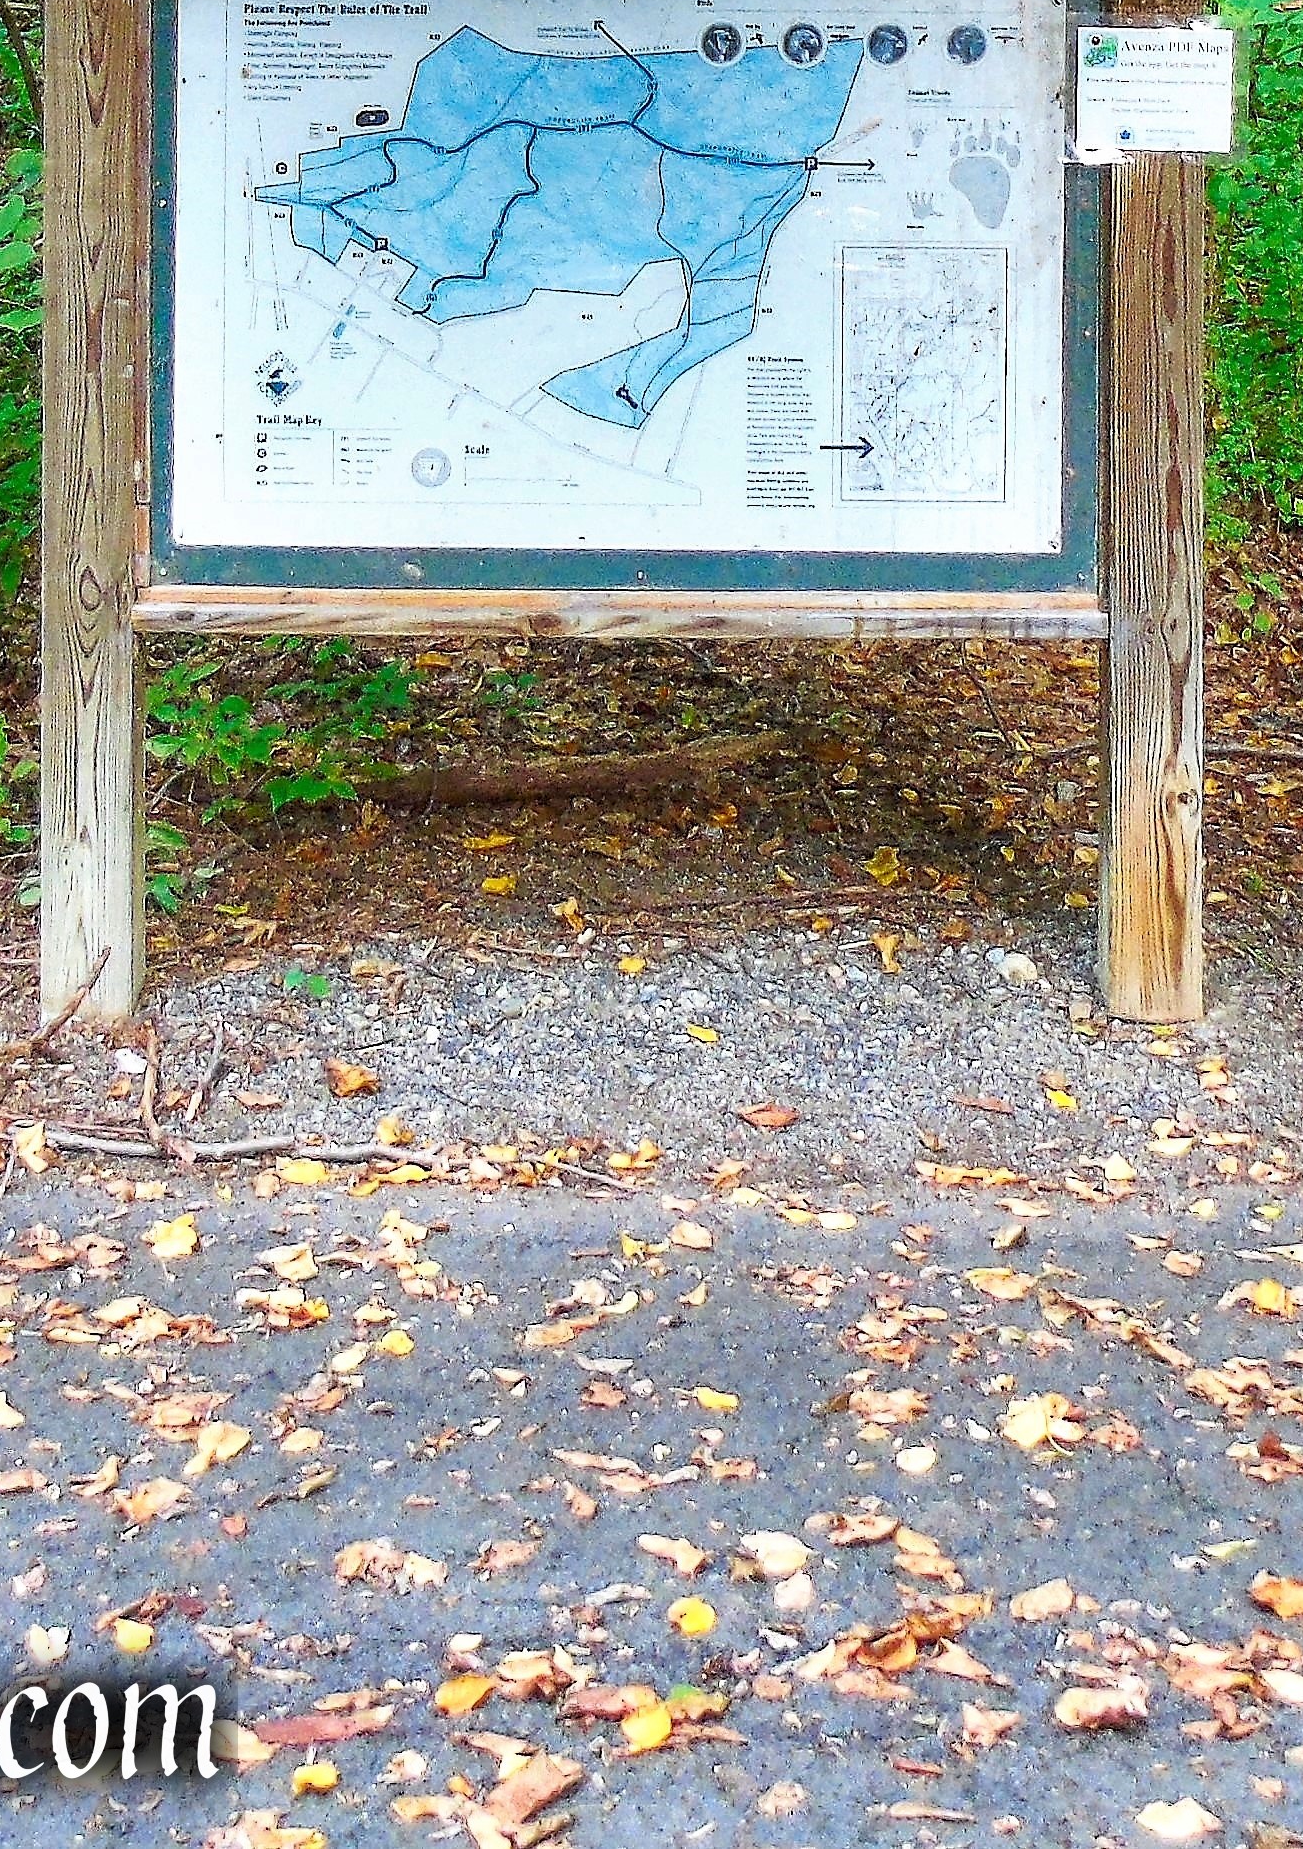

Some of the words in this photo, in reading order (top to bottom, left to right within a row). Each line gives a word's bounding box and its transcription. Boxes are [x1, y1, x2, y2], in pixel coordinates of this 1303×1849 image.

[318, 4, 336, 14] The
[370, 4, 379, 15] of
[382, 5, 401, 15] The
[403, 5, 428, 15] Trail
[1121, 40, 1165, 52] Avenza
[1169, 41, 1192, 52] PDF
[1198, 42, 1229, 55] Maps
[256, 414, 280, 424] Trail
[283, 414, 303, 427] Map
[305, 414, 322, 427] Key
[464, 445, 490, 455] Scale
